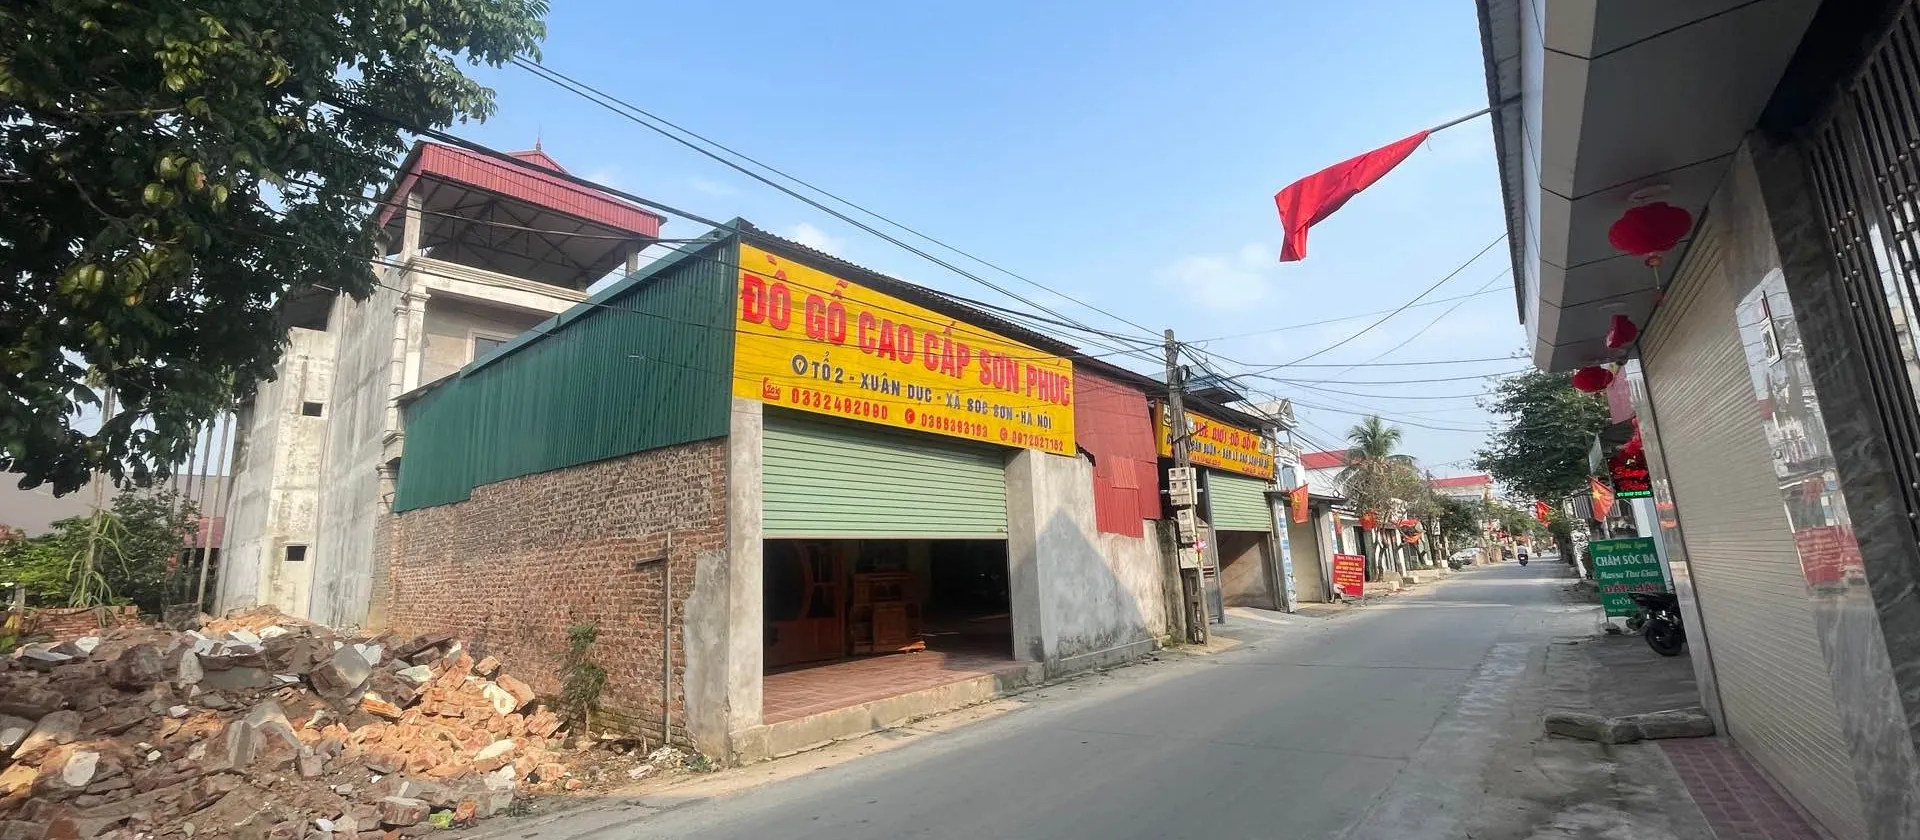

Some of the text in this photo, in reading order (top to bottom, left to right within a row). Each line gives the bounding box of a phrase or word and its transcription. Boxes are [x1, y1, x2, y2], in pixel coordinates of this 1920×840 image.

[741, 255, 1071, 406] ĐỒ GỖ CAO CẤP SƠN PHÚC
[811, 350, 831, 381] TỔ
[834, 367, 844, 384] 2
[860, 372, 900, 396] XUÂN
[907, 384, 932, 406] DỤC
[1622, 552, 1641, 565] SÓC
